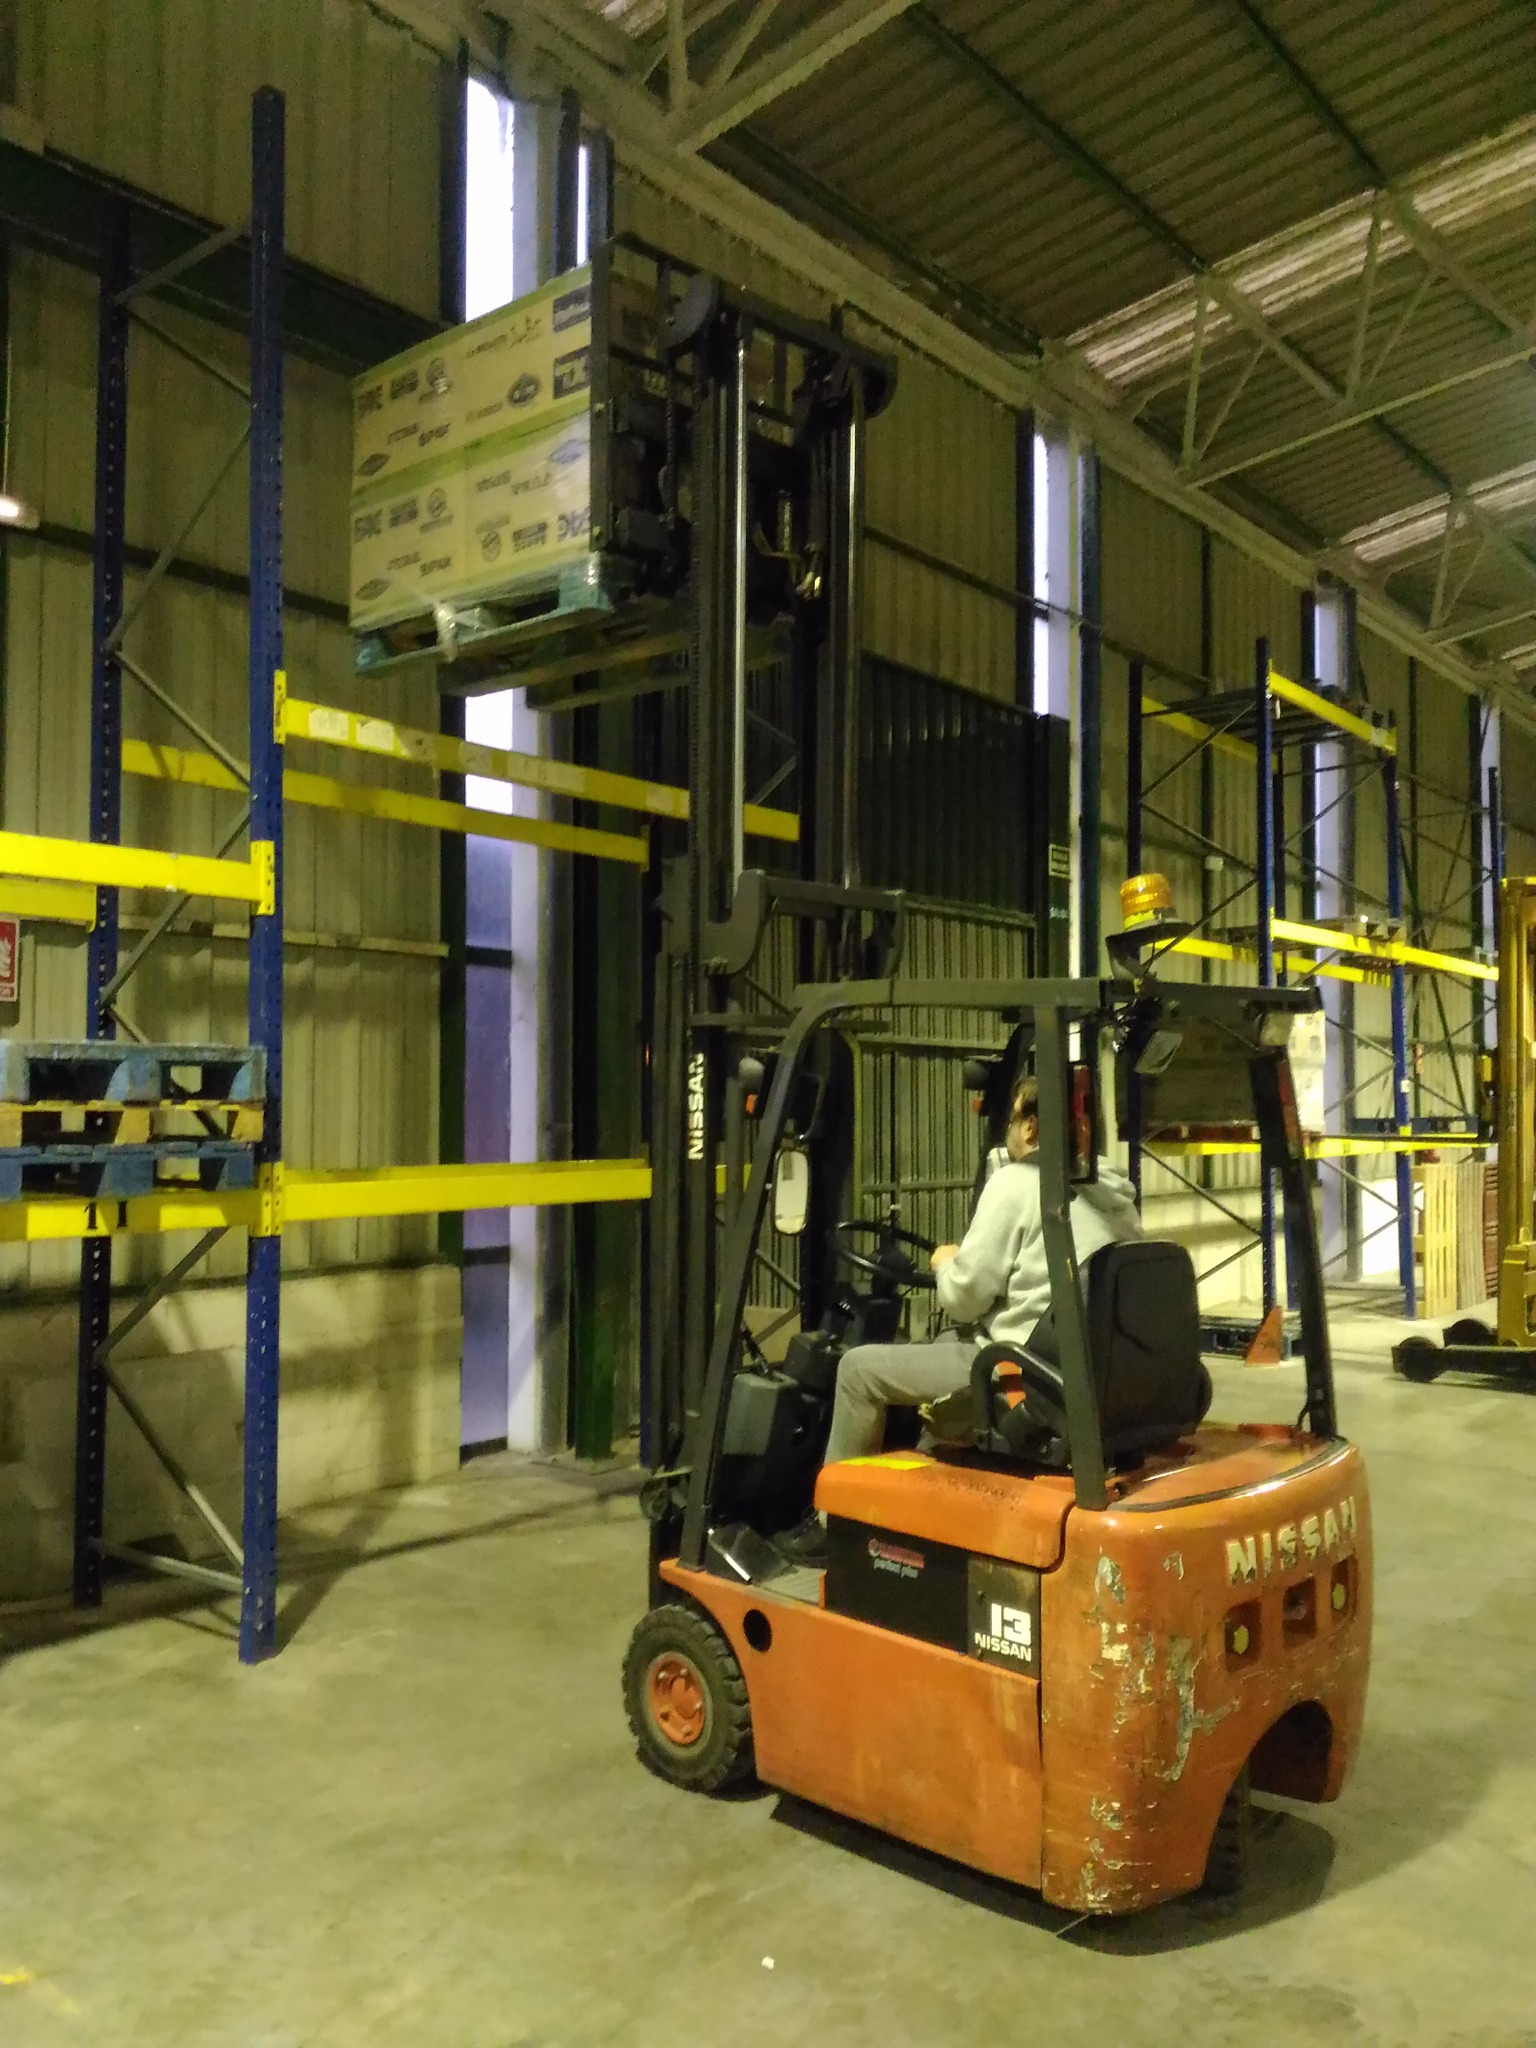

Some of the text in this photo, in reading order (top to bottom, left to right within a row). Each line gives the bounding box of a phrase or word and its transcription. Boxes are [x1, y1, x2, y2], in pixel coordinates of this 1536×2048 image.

[688, 1052, 704, 1160] NISSAN
[1227, 1495, 1357, 1587] NISSAN
[974, 1632, 1032, 1662] NISSAN
[991, 1603, 1032, 1646] 13
